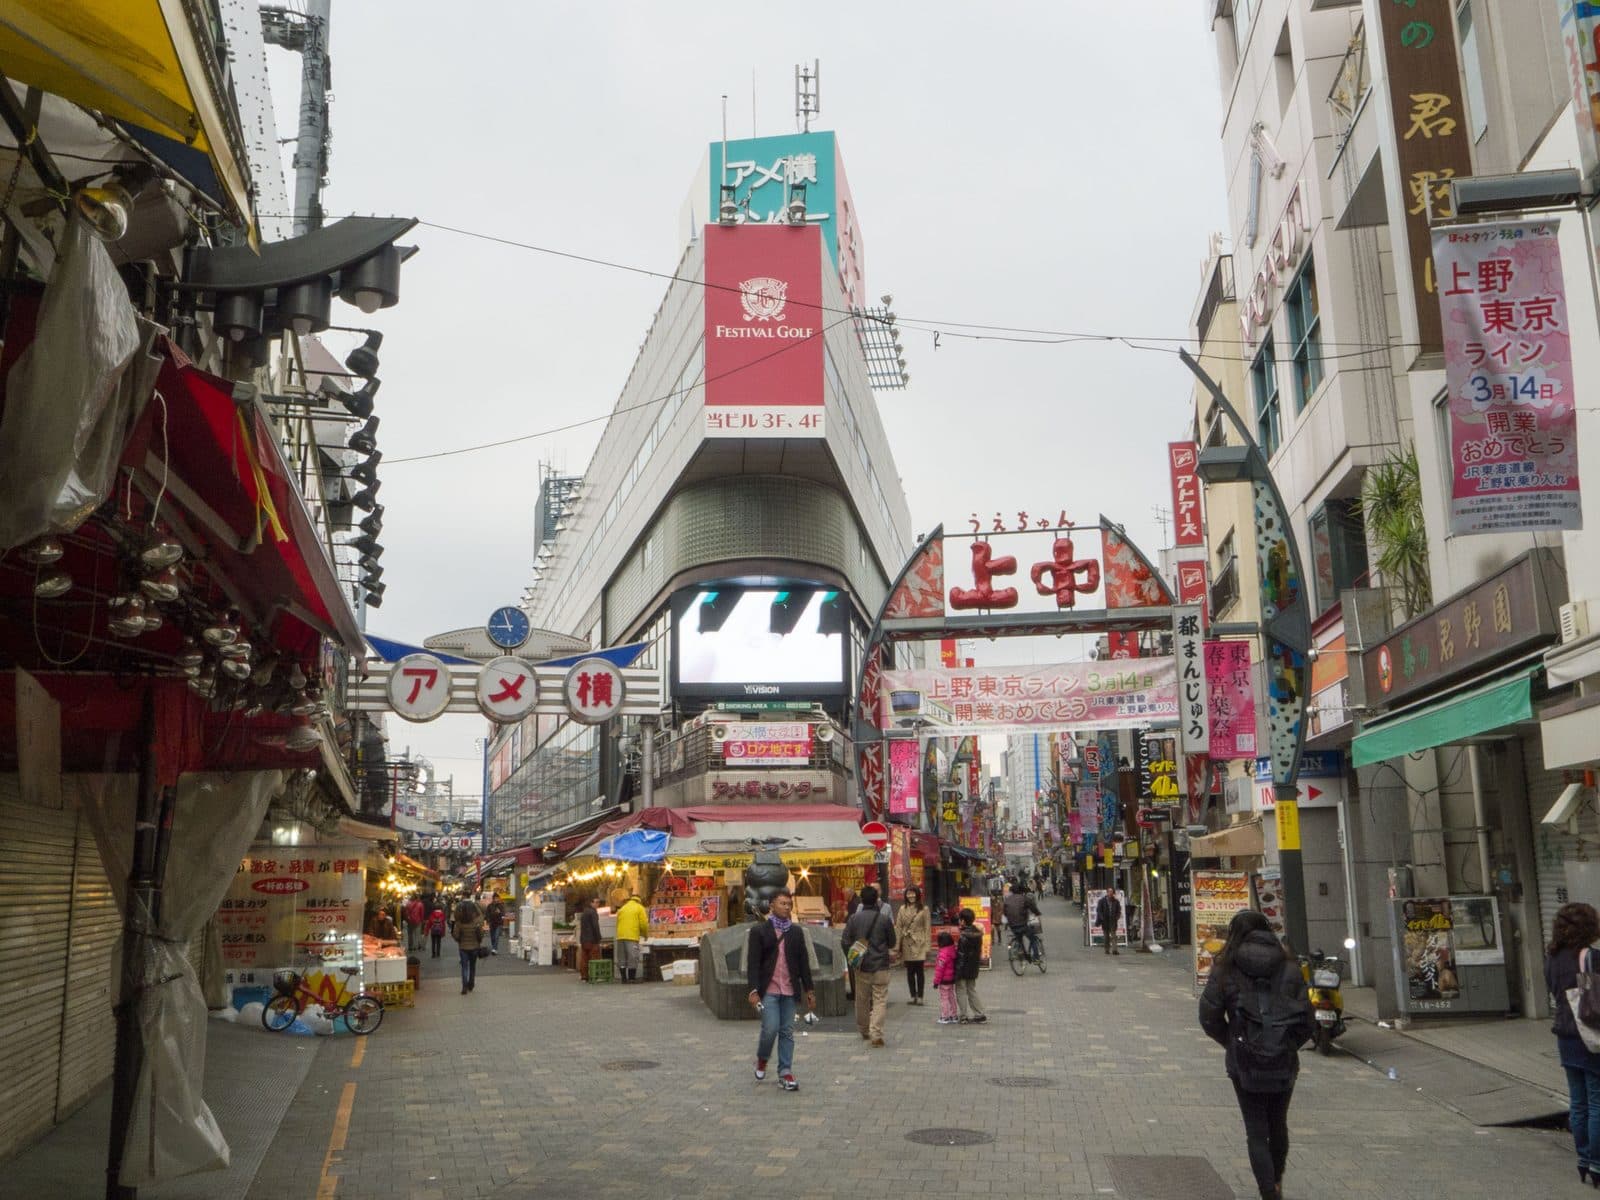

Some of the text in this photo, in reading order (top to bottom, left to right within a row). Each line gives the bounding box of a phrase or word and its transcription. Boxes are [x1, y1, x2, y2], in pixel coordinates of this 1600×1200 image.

[726, 152, 818, 188] アメ横
[1444, 259, 1514, 297] 上野
[1479, 298, 1559, 336] 東京
[716, 325, 813, 338] FESTIVAL GOLF
[1464, 342, 1544, 366] ライン
[1471, 375, 1554, 402] 3月14日
[707, 412, 758, 429] 当ビル
[1486, 411, 1537, 434] 開業
[1462, 436, 1566, 462] おめでとう
[949, 537, 1101, 611] 上中
[926, 671, 1154, 700] 上野東京ライン 3月14日
[1177, 614, 1205, 740] 都まんじゅう
[954, 698, 1088, 723] 開業おめでとう
[1115, 701, 1179, 716] 上野駅乗り入
[711, 780, 828, 800] アメ横センター
